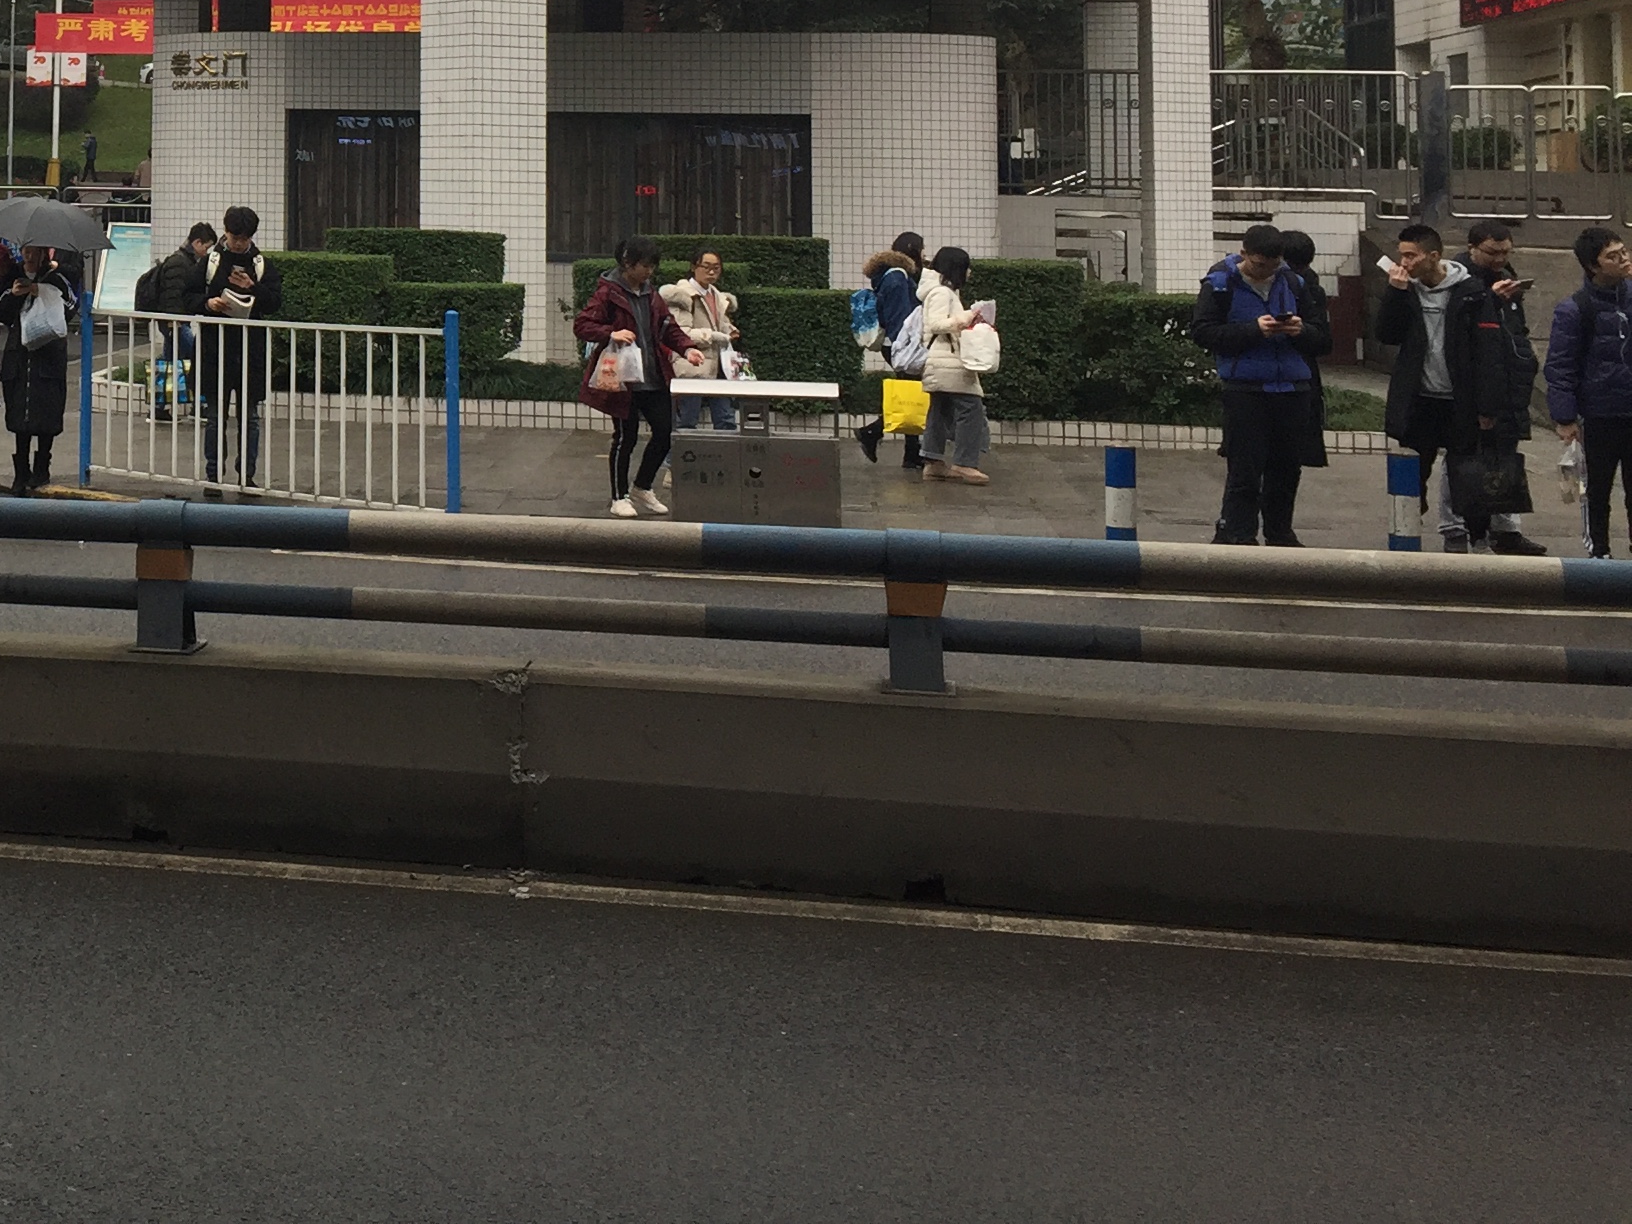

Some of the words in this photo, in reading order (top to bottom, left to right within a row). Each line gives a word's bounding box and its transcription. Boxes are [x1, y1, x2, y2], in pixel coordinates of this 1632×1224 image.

[55, 17, 150, 42] 严肃考
[170, 49, 248, 77] 崇文门
[171, 79, 249, 91] CHONGWENMEN
